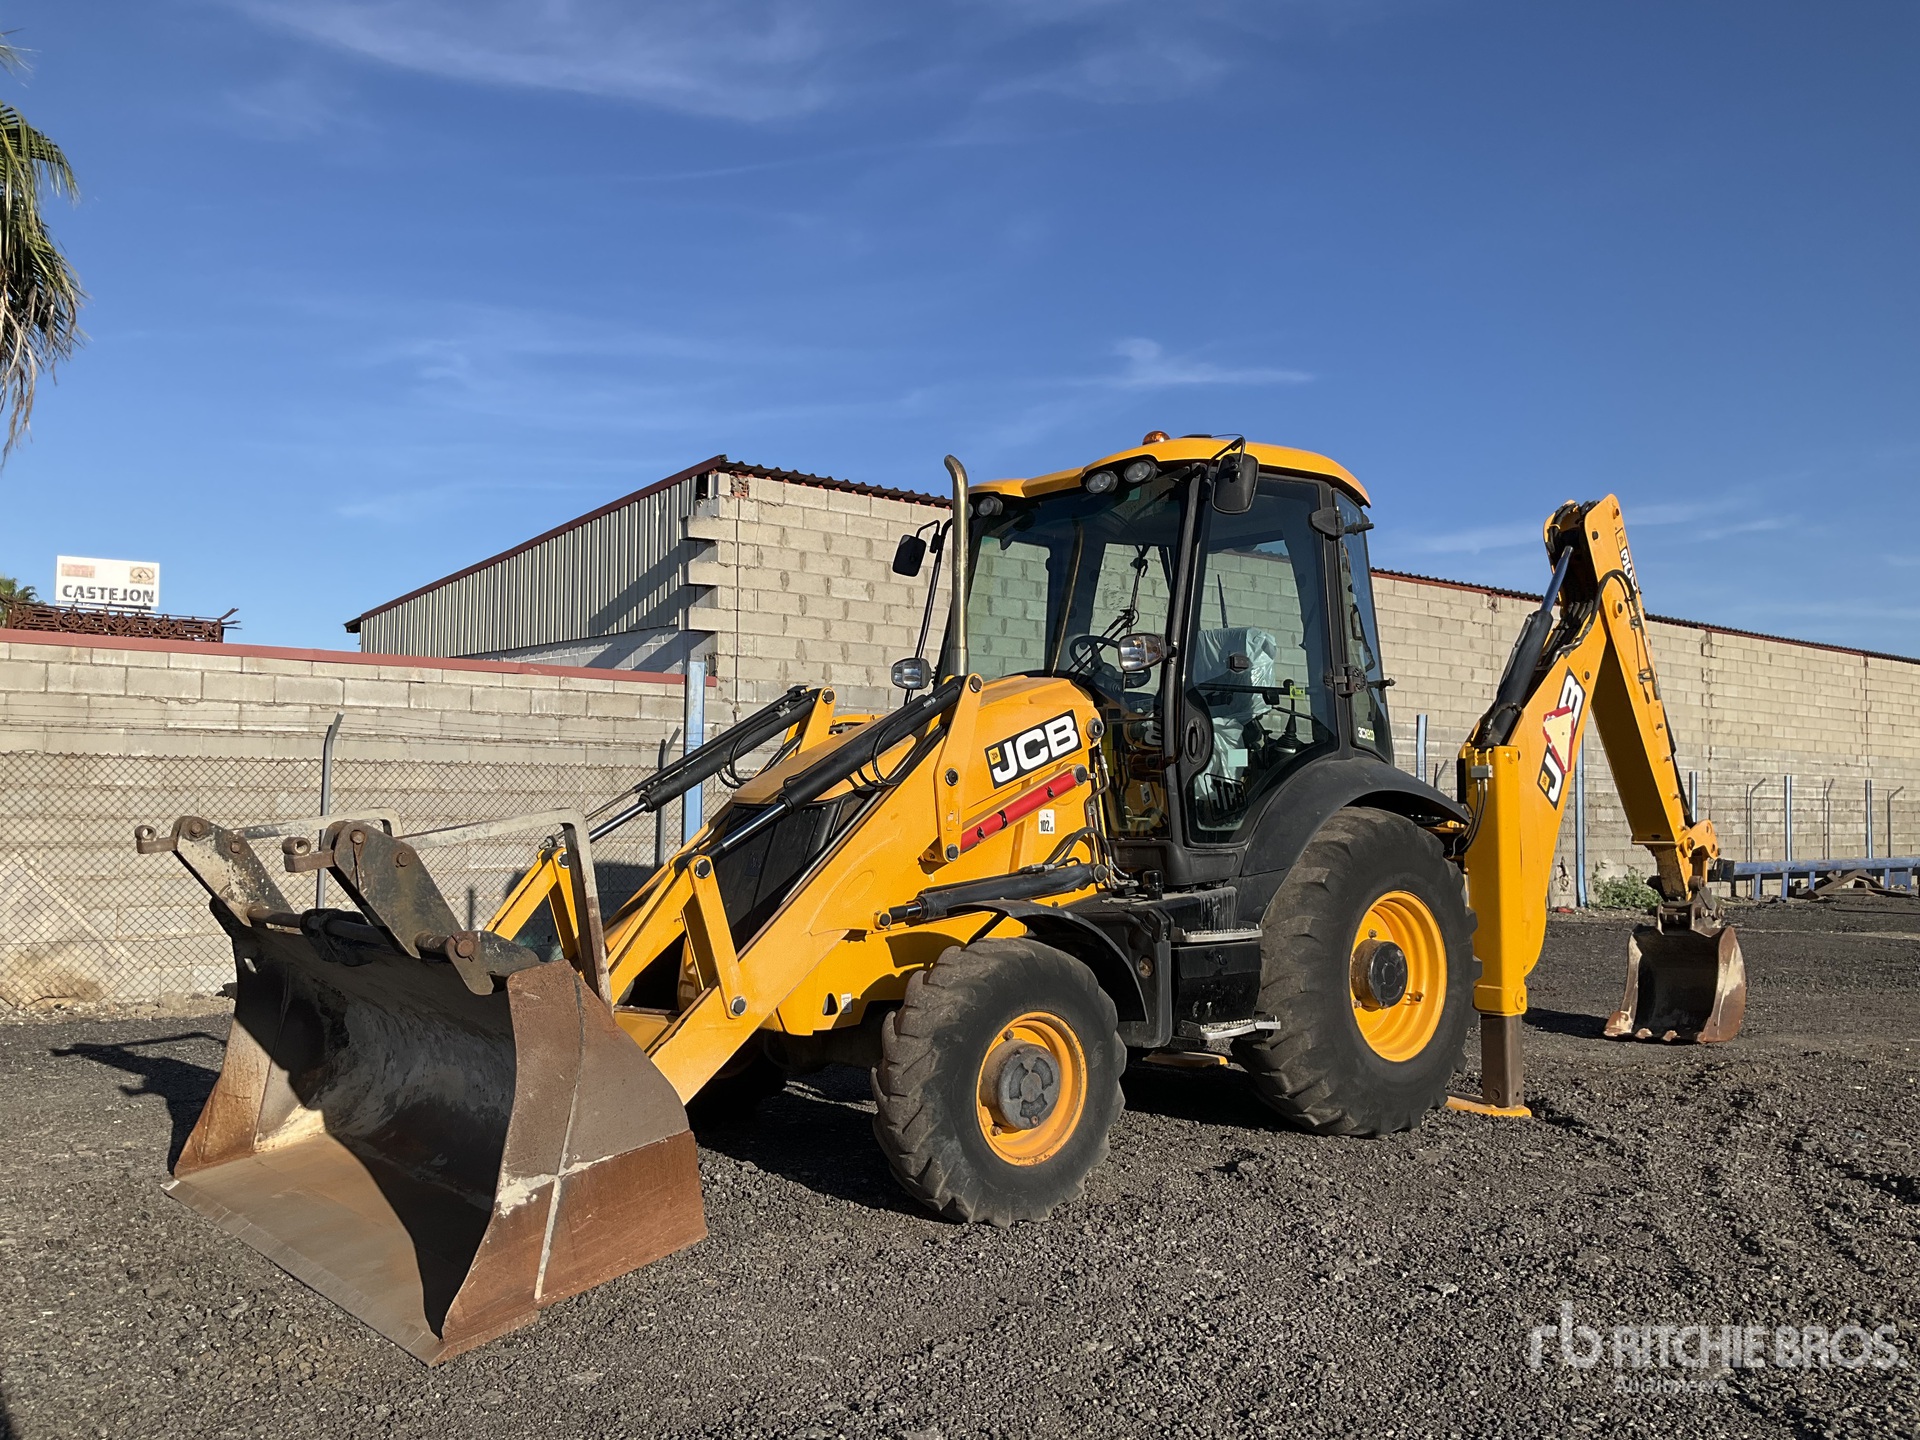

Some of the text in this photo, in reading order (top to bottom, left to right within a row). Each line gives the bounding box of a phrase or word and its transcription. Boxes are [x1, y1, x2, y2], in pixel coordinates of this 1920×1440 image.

[62, 584, 155, 603] CASTEJON
[992, 715, 1079, 783] JCB
[1544, 674, 1583, 803] JB
[1211, 778, 1248, 813] JCB
